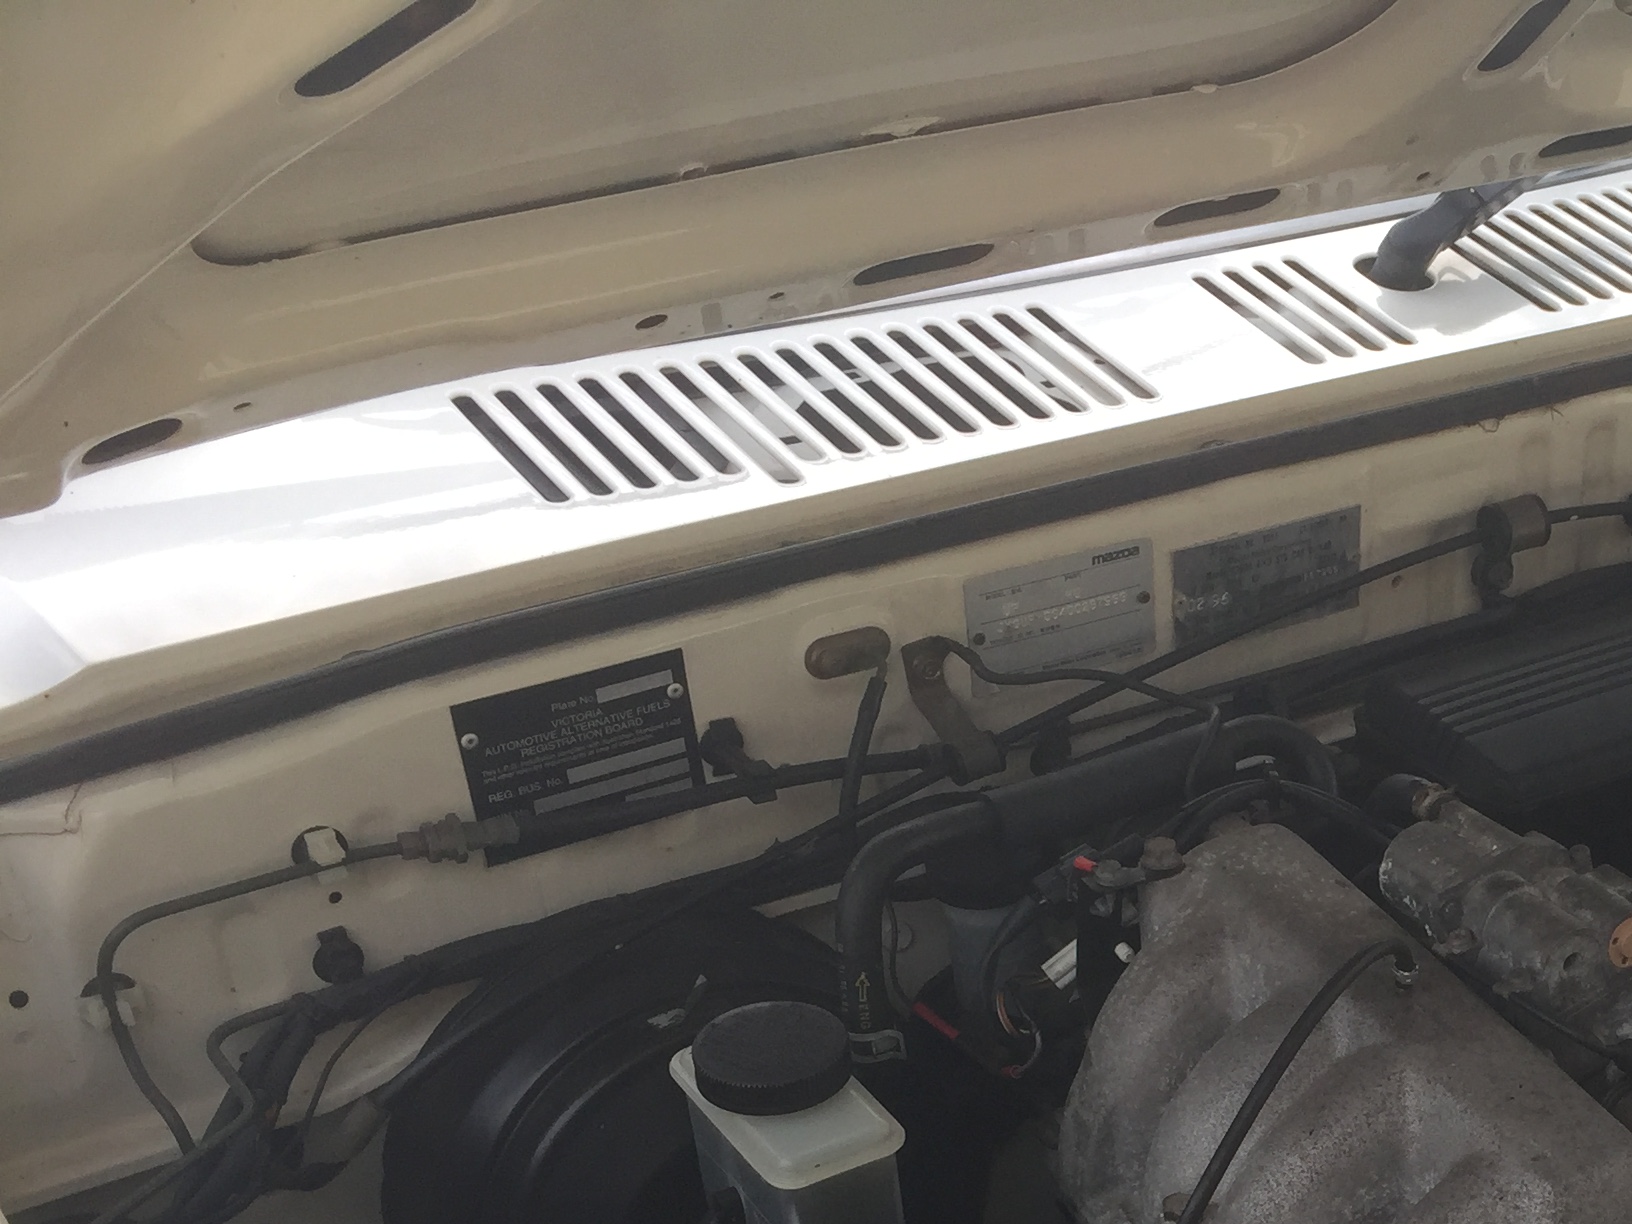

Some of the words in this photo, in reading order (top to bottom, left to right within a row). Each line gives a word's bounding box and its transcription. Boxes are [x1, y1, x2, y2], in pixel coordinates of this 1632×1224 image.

[1090, 545, 1141, 565] mazda
[550, 697, 577, 713] Plate
[483, 729, 557, 758] AUTOMOTIVE
[559, 708, 633, 736] ALTERNATIVE
[636, 698, 671, 716] FUELS
[551, 707, 603, 729] VICTORIA
[520, 727, 602, 758] REGISTRATION
[604, 716, 643, 735] BOARD
